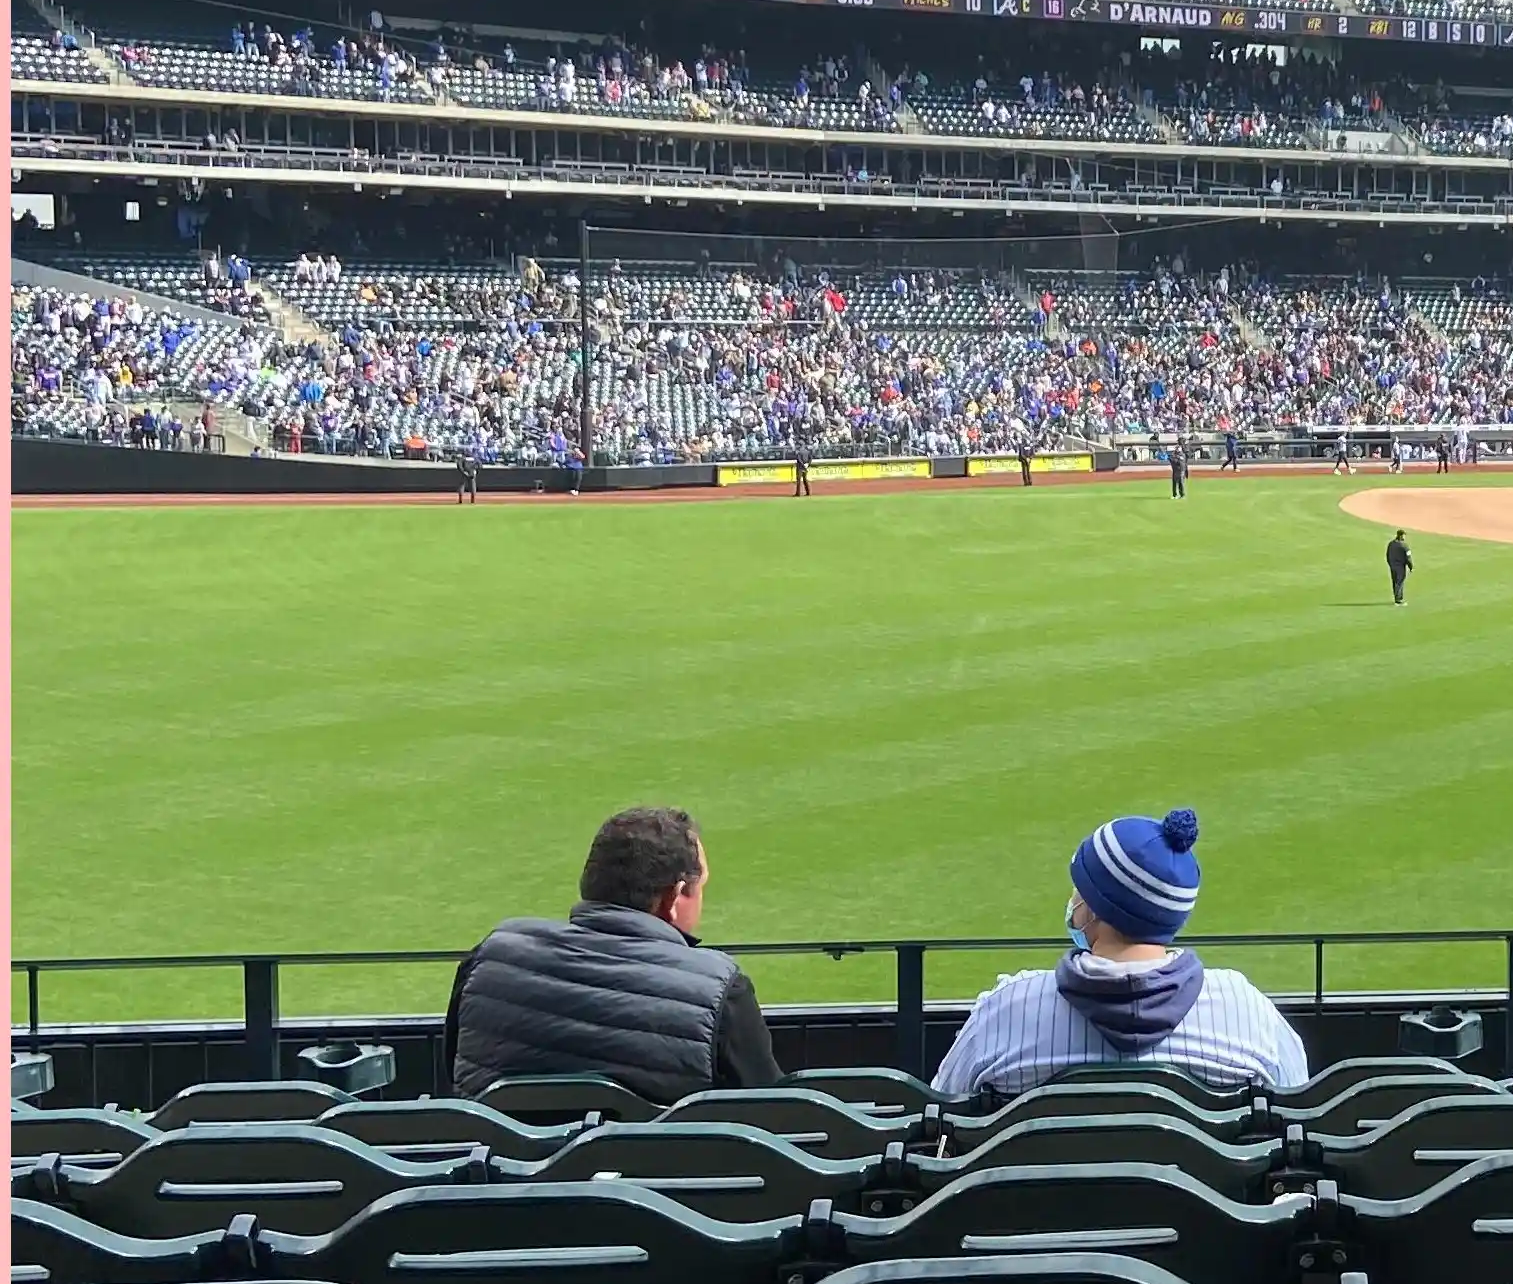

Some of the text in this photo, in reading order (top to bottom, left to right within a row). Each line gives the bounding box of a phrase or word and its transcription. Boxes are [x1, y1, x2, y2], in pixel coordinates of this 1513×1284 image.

[1109, 2, 1212, 26] D'ARNAUD
[1254, 11, 1287, 31] .304
[1307, 17, 1322, 32] HR
[1337, 16, 1348, 35] 2
[1402, 20, 1417, 38] 12
[1428, 21, 1438, 40] B
[1451, 22, 1461, 42] S
